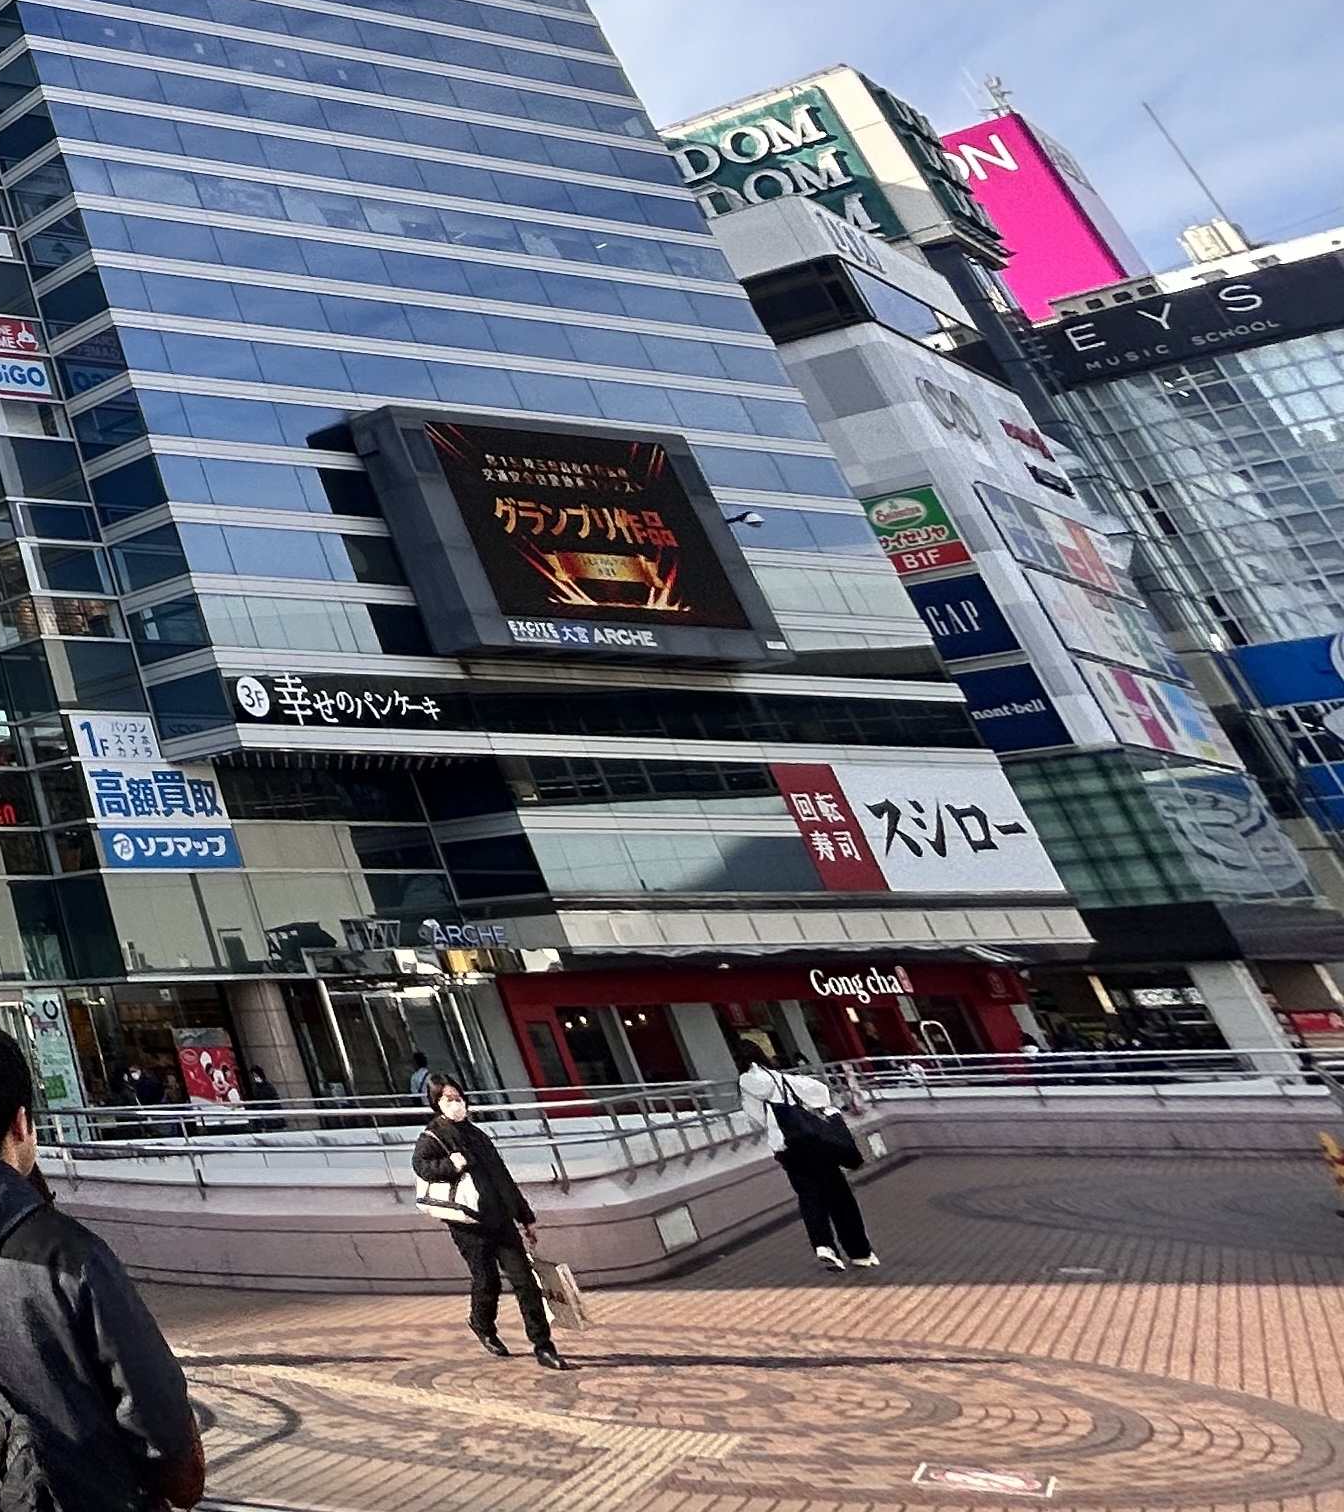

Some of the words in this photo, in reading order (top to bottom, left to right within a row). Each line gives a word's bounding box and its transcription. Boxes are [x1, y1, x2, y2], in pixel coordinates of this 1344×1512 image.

[674, 103, 829, 185] DOM
[1085, 343, 1171, 372] MUSIC
[1191, 318, 1283, 347] SCHOOL
[493, 496, 680, 548] グランプリ作品
[900, 548, 941, 569] B1F
[560, 625, 590, 644] 大宮
[593, 626, 658, 647] ARCHE
[924, 599, 983, 637] GAP
[273, 672, 442, 726] 幸せのパンケーキ
[80, 720, 110, 758] 1F
[88, 769, 223, 818] 高額買取
[788, 790, 846, 823] 回転
[135, 834, 227, 858] ソフマップ
[808, 829, 863, 863] 寿司
[864, 797, 1028, 859] スシロー
[432, 924, 511, 944] ARCHE
[810, 968, 871, 1003] Gong
[867, 967, 904, 995] cha
